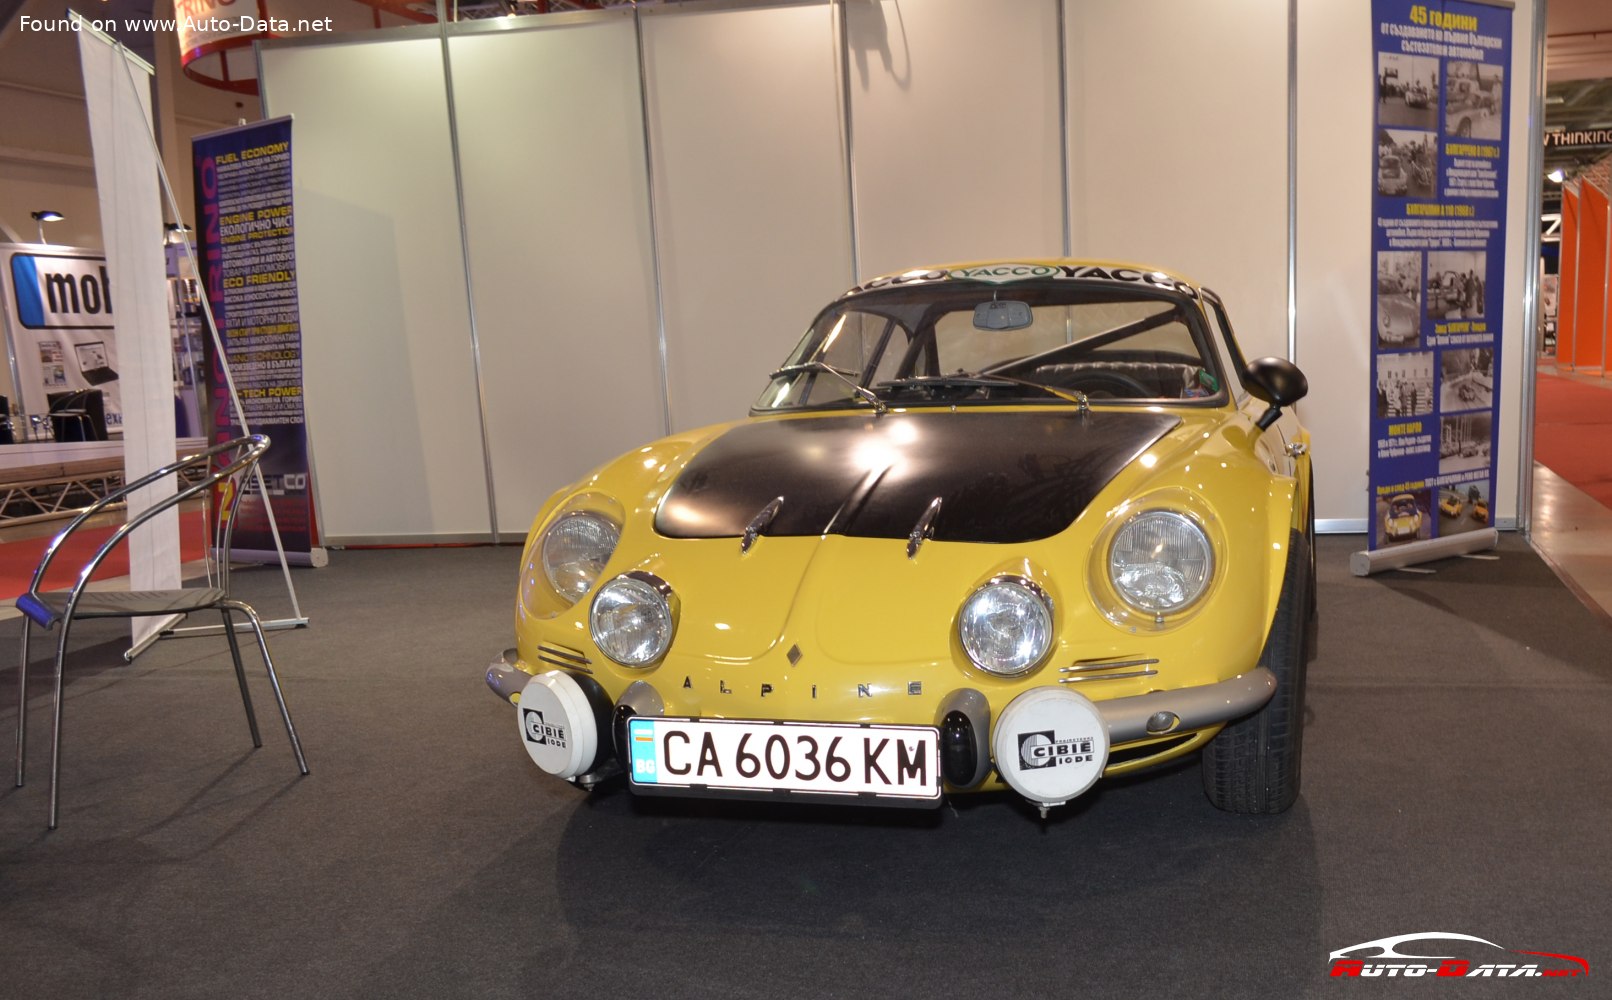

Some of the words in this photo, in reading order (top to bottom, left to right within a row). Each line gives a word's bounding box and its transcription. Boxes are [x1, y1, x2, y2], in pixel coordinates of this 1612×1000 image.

[1410, 5, 1428, 25] 45
[215, 152, 238, 164] FUEL
[240, 141, 288, 159] ECONOMY
[219, 211, 254, 225] ENGINE
[223, 277, 243, 288] ECO
[246, 269, 295, 284] FRIENDLY
[961, 265, 1052, 279] YACCO
[1058, 265, 1199, 300] YACCO
[683, 675, 923, 699] ALPINE
[547, 738, 567, 748] IODE
[635, 759, 655, 774] BG
[663, 730, 723, 778] CA
[736, 732, 852, 783] 6036
[864, 737, 927, 787] KM
[1058, 755, 1094, 765] IODE
